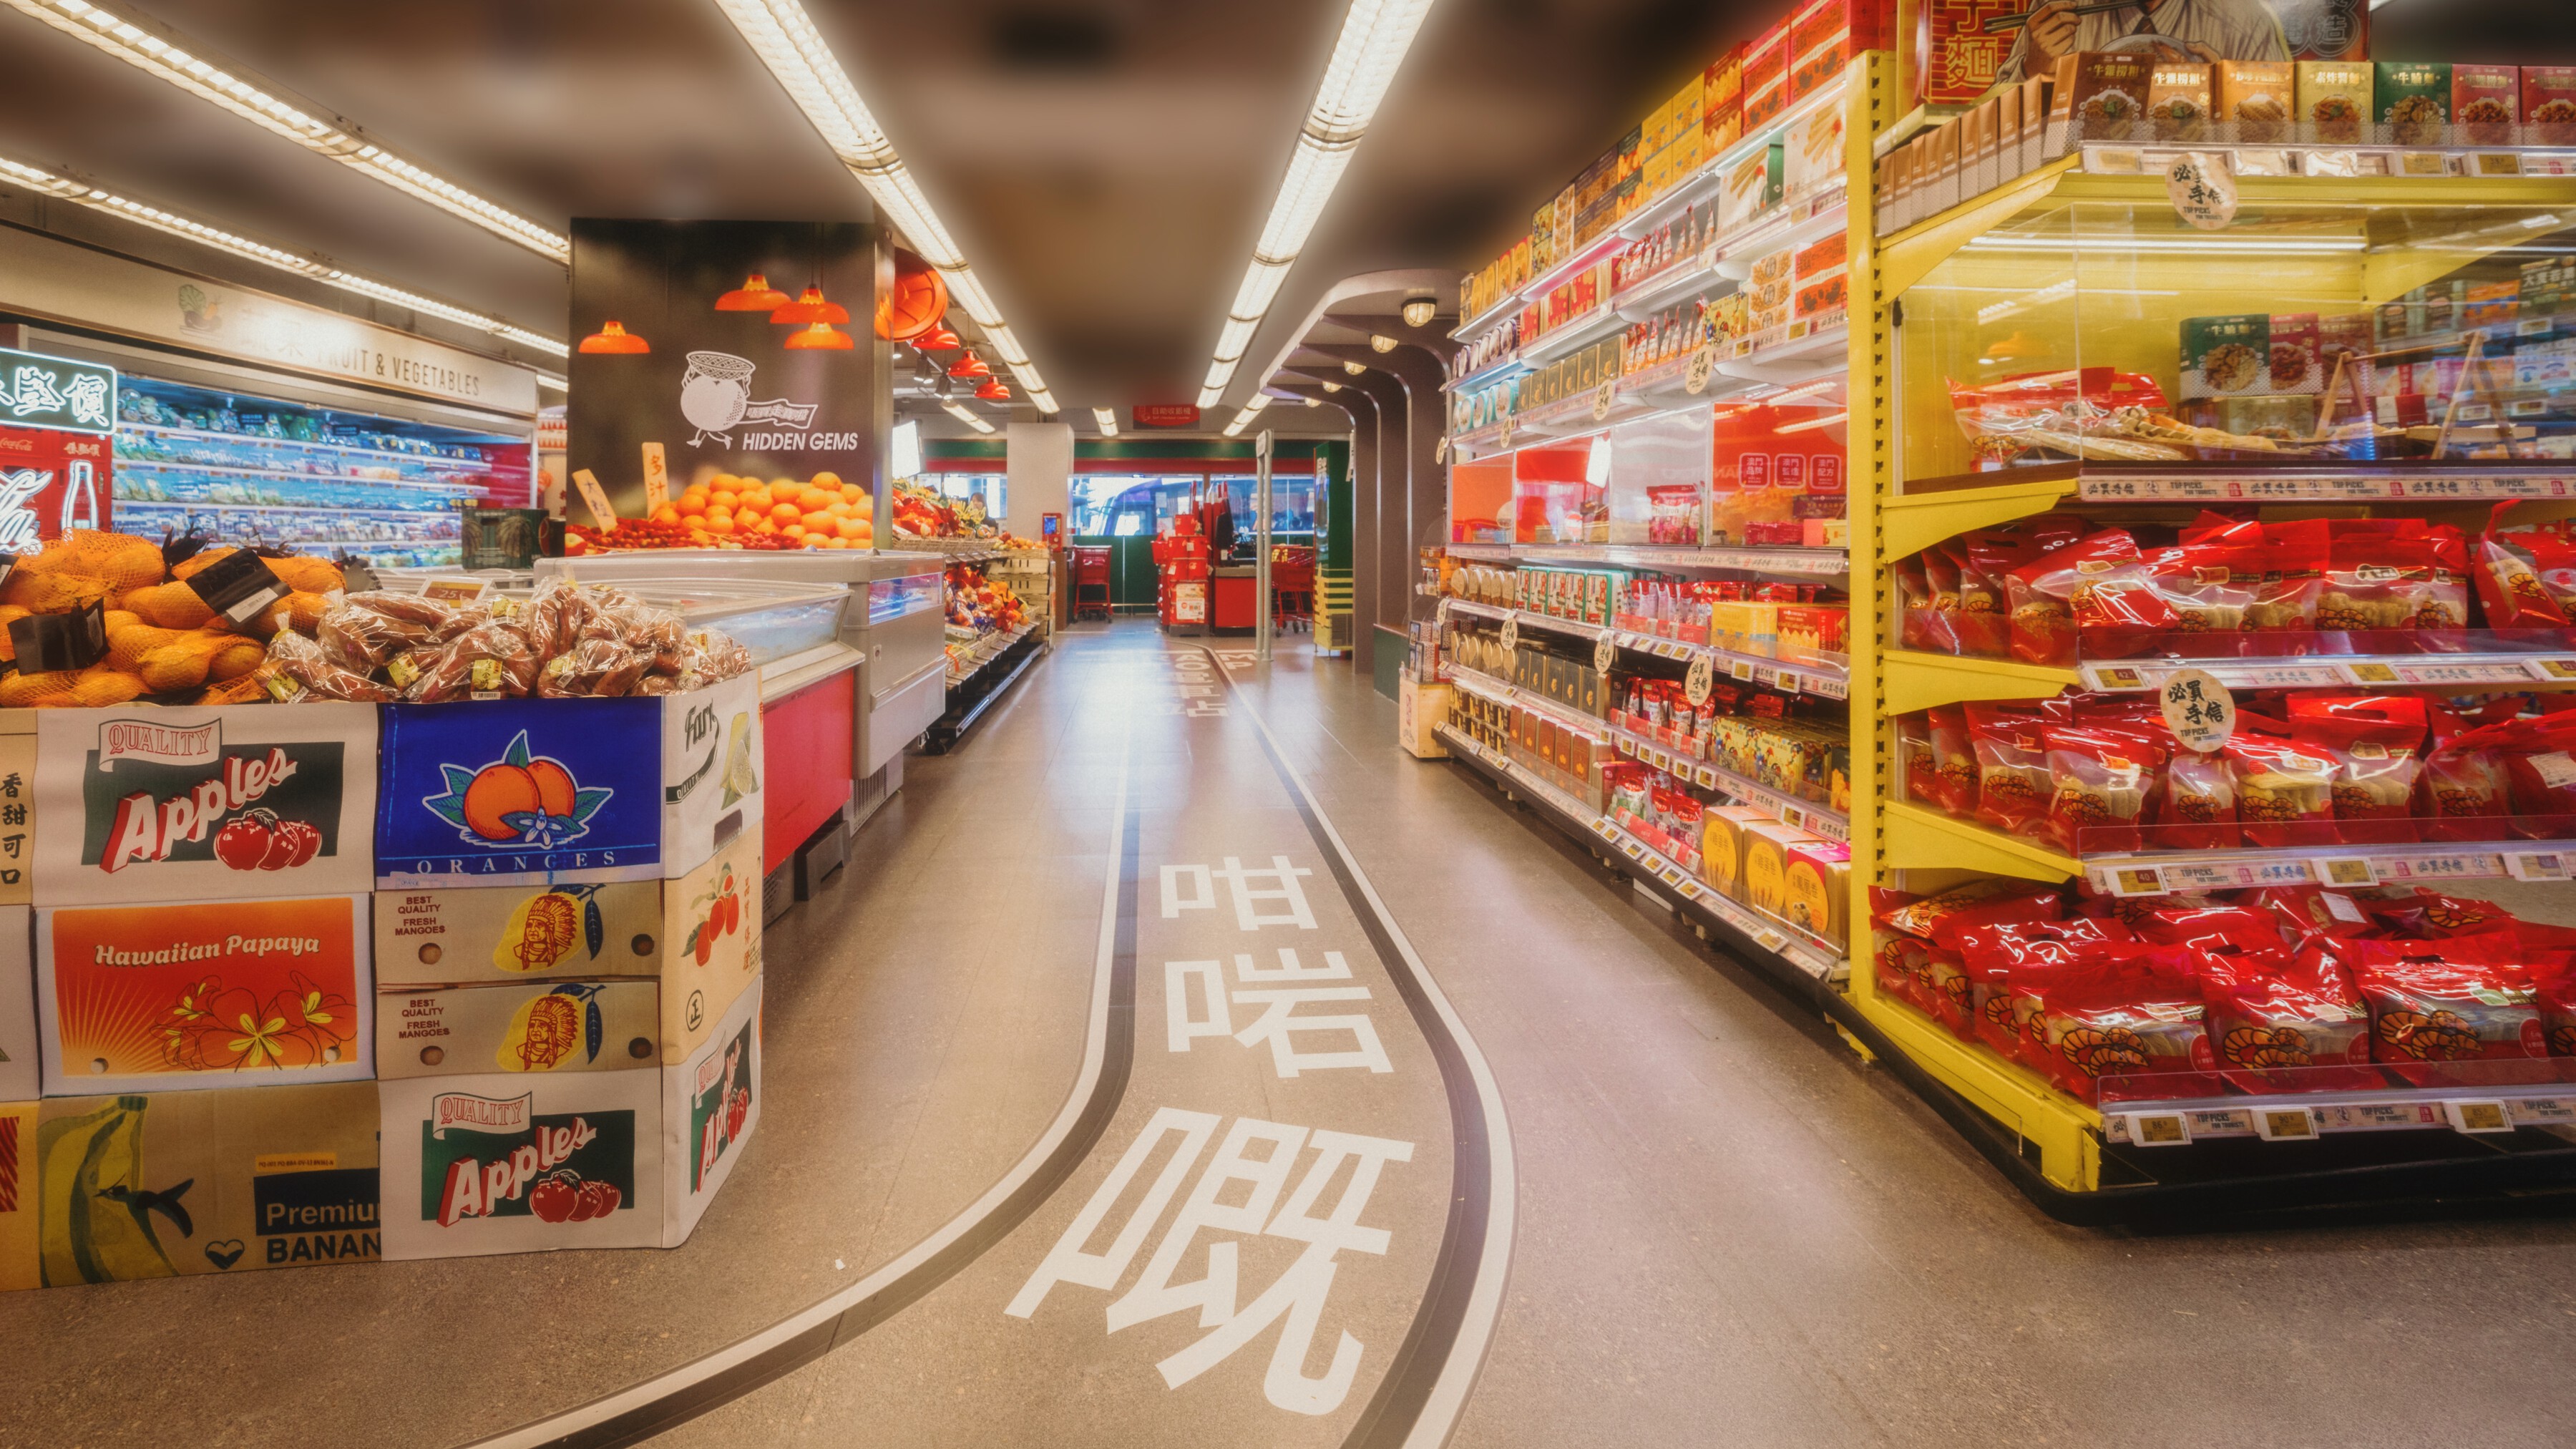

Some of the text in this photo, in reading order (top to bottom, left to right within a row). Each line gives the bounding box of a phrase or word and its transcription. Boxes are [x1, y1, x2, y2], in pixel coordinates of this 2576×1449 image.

[376, 353, 386, 377] &
[393, 356, 480, 396] VEGETABLES
[743, 432, 858, 451] HIDDEN GEMS
[1747, 457, 1763, 467] 澳門
[650, 454, 665, 498] 多汁
[2168, 679, 2205, 703] 必買
[2185, 701, 2225, 725] 手信
[108, 725, 212, 756] QUALITY
[2191, 727, 2209, 736] PICKS
[99, 748, 298, 874] Apples
[1, 773, 27, 885] 香甜可口
[416, 851, 616, 875] ORANGES
[2197, 868, 2214, 877] PICKS
[397, 904, 441, 914] QUALITY
[406, 895, 433, 905] BEST
[394, 925, 447, 936] MANGOES
[402, 917, 437, 927] FRESH
[94, 934, 321, 967] Hawaiian Papaya
[401, 1007, 445, 1018] QUALITY
[409, 998, 436, 1008] BEST
[690, 998, 701, 1025] 正
[399, 1028, 451, 1040] MANGOES
[406, 1020, 441, 1030] FRESH
[440, 1097, 524, 1126] QUALITY
[696, 1038, 742, 1192] Apples
[2360, 1107, 2394, 1116] TOP PICKS
[2522, 1101, 2557, 1111] TOP PICKS
[2197, 1113, 2230, 1121] TOP PICKS
[436, 1117, 597, 1227] Apples
[266, 1198, 381, 1227] Premiu
[267, 1231, 382, 1264] BANAN
